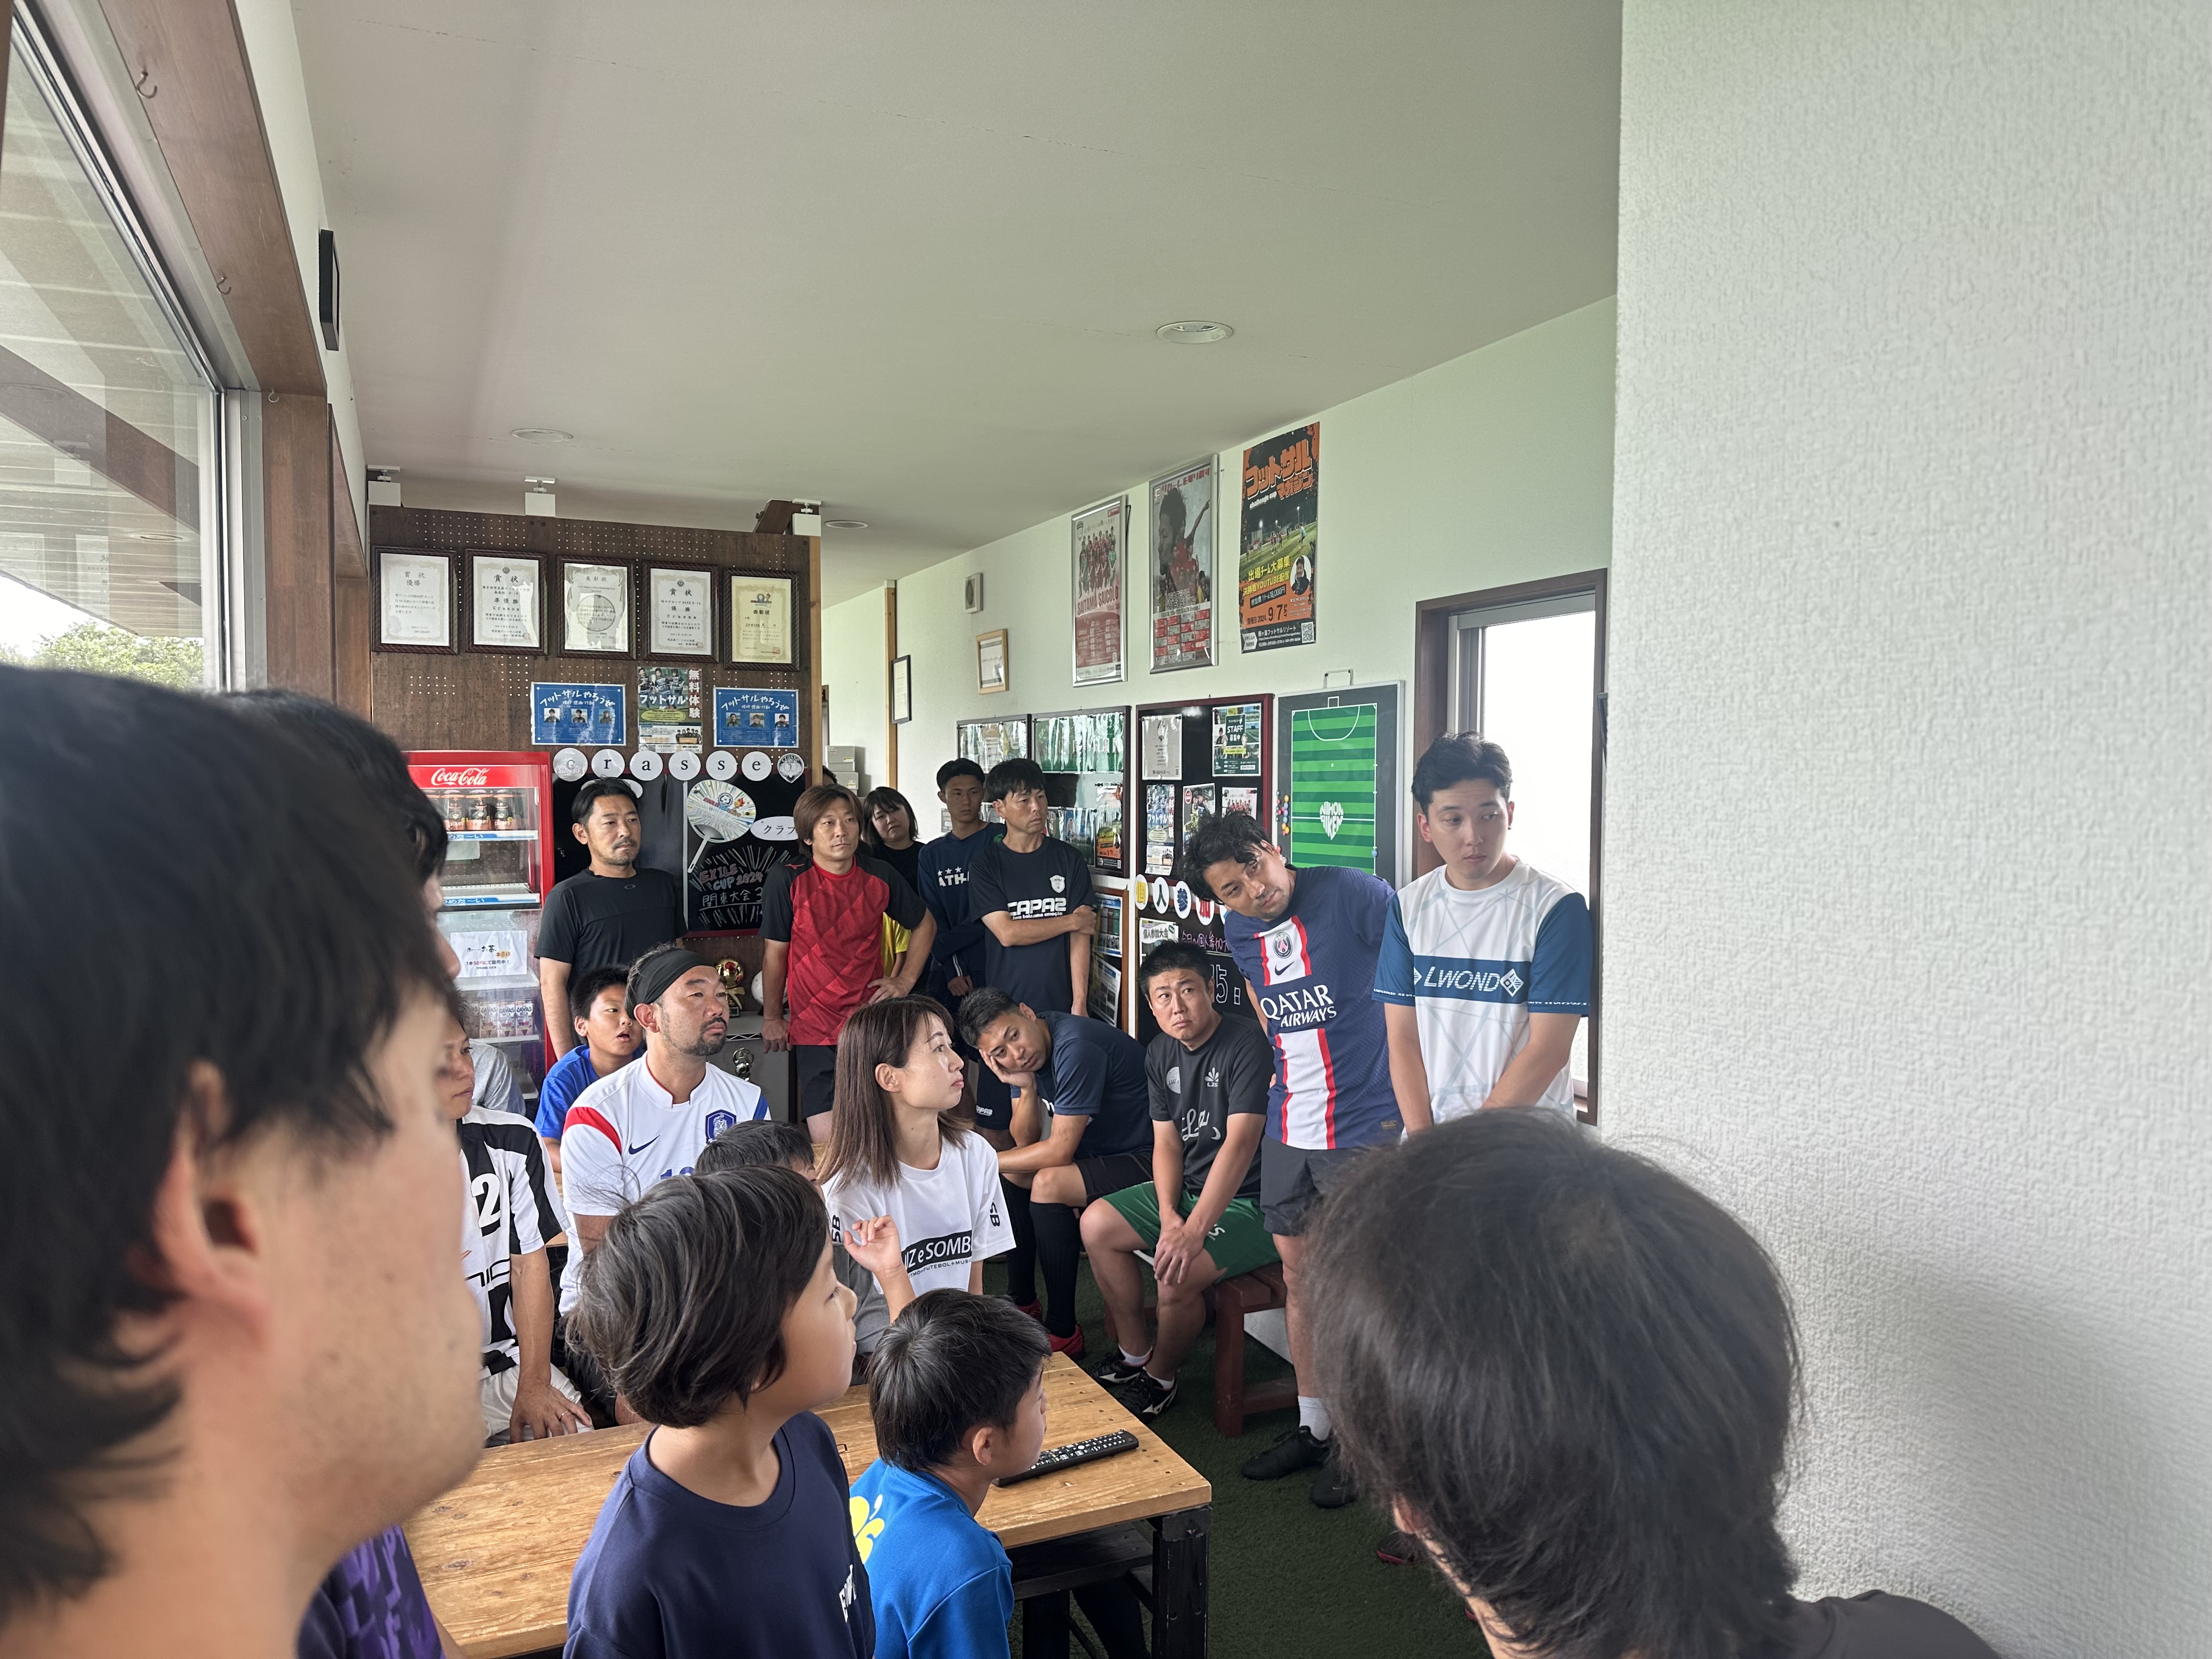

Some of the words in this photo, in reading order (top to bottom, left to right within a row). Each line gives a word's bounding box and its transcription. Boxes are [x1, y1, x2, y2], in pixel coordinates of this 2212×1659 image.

[1246, 439, 1312, 500] フットサル
[1277, 471, 1313, 500] マガジン
[1250, 494, 1269, 510] challenge
[1269, 490, 1277, 499] cup
[1248, 555, 1291, 582] 出場チーム大募集
[406, 579, 421, 587] 優勝
[494, 574, 518, 583] 賞状
[669, 588, 692, 596] 賞状
[1077, 595, 1097, 616] SAITAMA
[1098, 585, 1119, 607] SAICOLO
[540, 690, 616, 707] フットサルやろうぜ
[639, 694, 686, 706] フットサル
[688, 670, 701, 719] 無料体験
[721, 694, 790, 711] フットサルやろうぜ
[1227, 725, 1244, 733] STAFF
[431, 768, 490, 786] Coca-Cola
[1319, 801, 1344, 816] NIHON
[1147, 814, 1167, 824] フットサル
[1319, 815, 1344, 840] AIKEN
[699, 863, 738, 883] EXILE
[713, 876, 735, 890] CUP
[736, 871, 764, 885] 2024
[938, 871, 970, 887] ATH
[702, 889, 752, 907] 関東大会
[1143, 928, 1169, 939] 個人参加大会
[1276, 933, 1288, 941] PARIS
[1424, 966, 1500, 992] LWOND
[1260, 985, 1334, 1020] QATAR
[1280, 1006, 1337, 1028] AIRWAYS
[918, 1249, 924, 1263] e
[926, 1235, 972, 1260] SOMB
[909, 1259, 972, 1279] TMO+FUTEBOL+MUS
